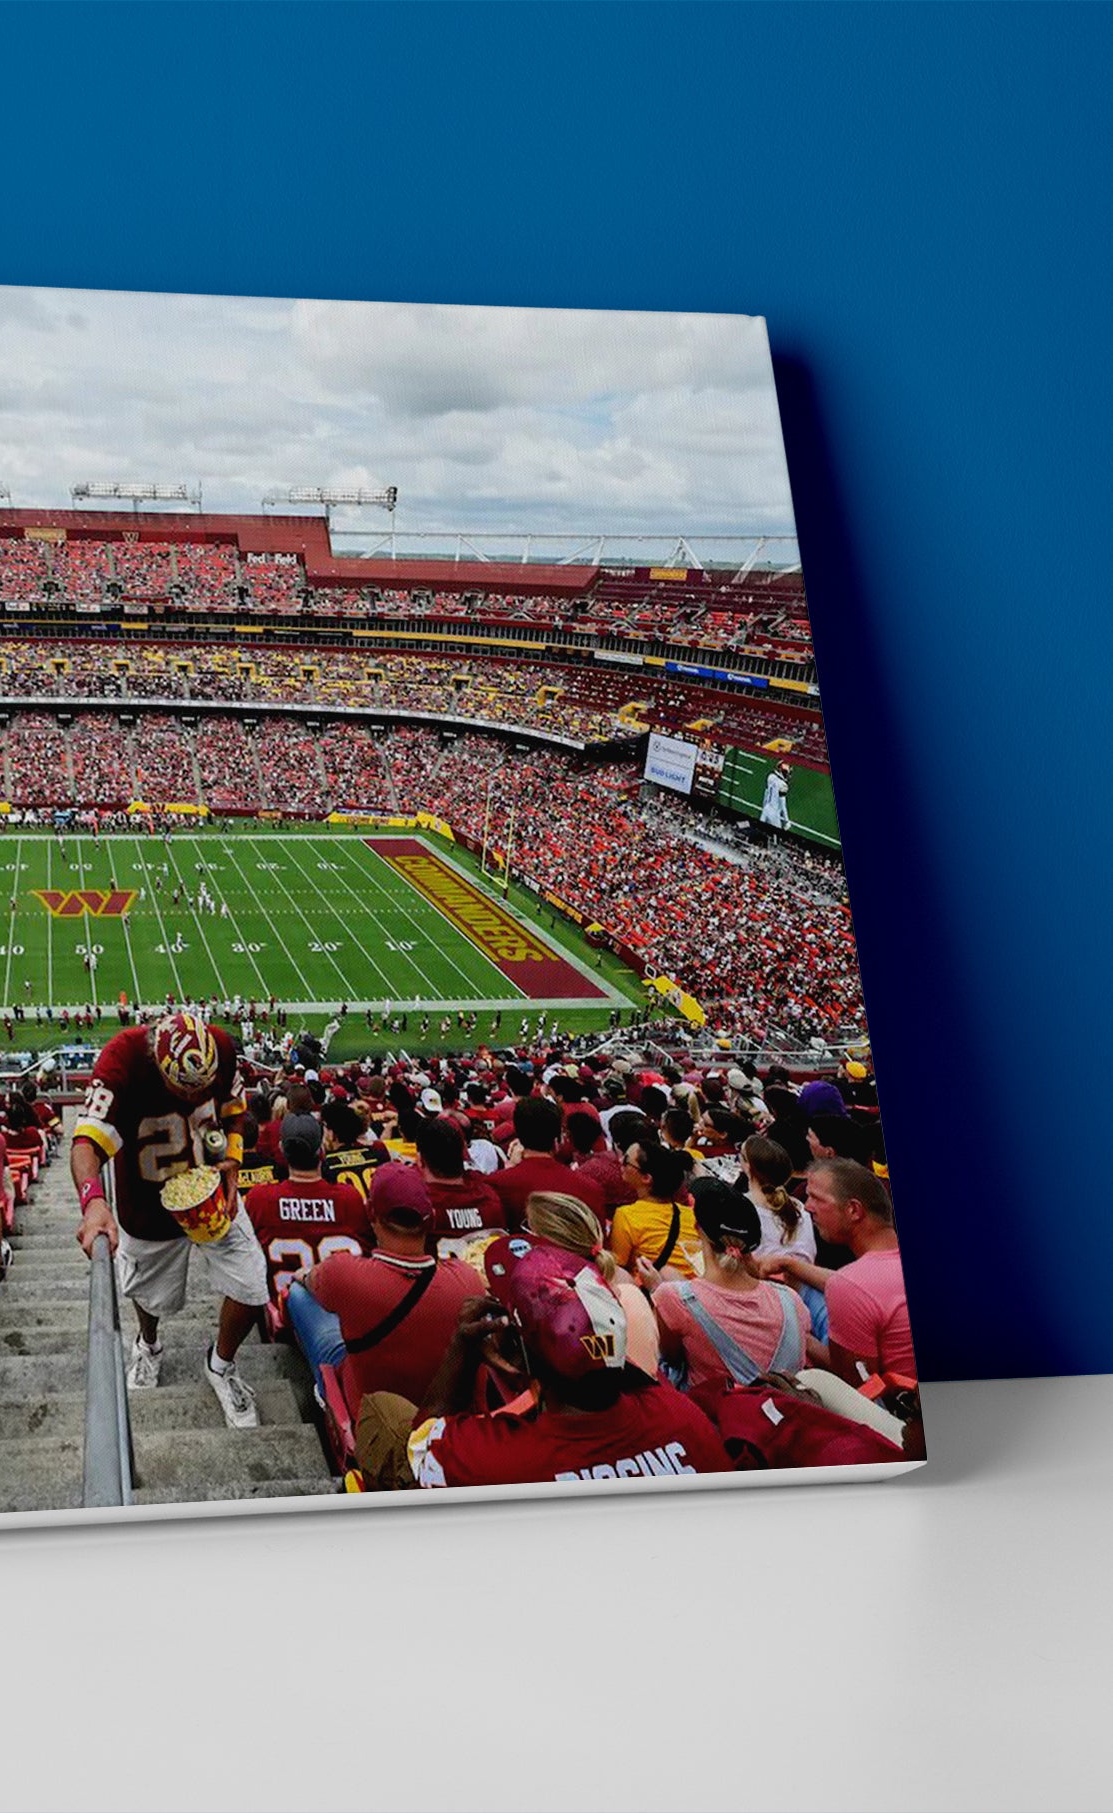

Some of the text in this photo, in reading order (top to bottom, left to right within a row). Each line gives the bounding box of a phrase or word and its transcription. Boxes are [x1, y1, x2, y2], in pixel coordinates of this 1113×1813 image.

[395, 855, 543, 962] COMMANDERS
[75, 944, 104, 954] 50
[155, 943, 183, 954] 40
[232, 942, 261, 952] 30
[308, 941, 338, 952] 20
[385, 940, 414, 951] 10
[279, 1197, 335, 1222] GREEN
[446, 1207, 483, 1229] YOUNG
